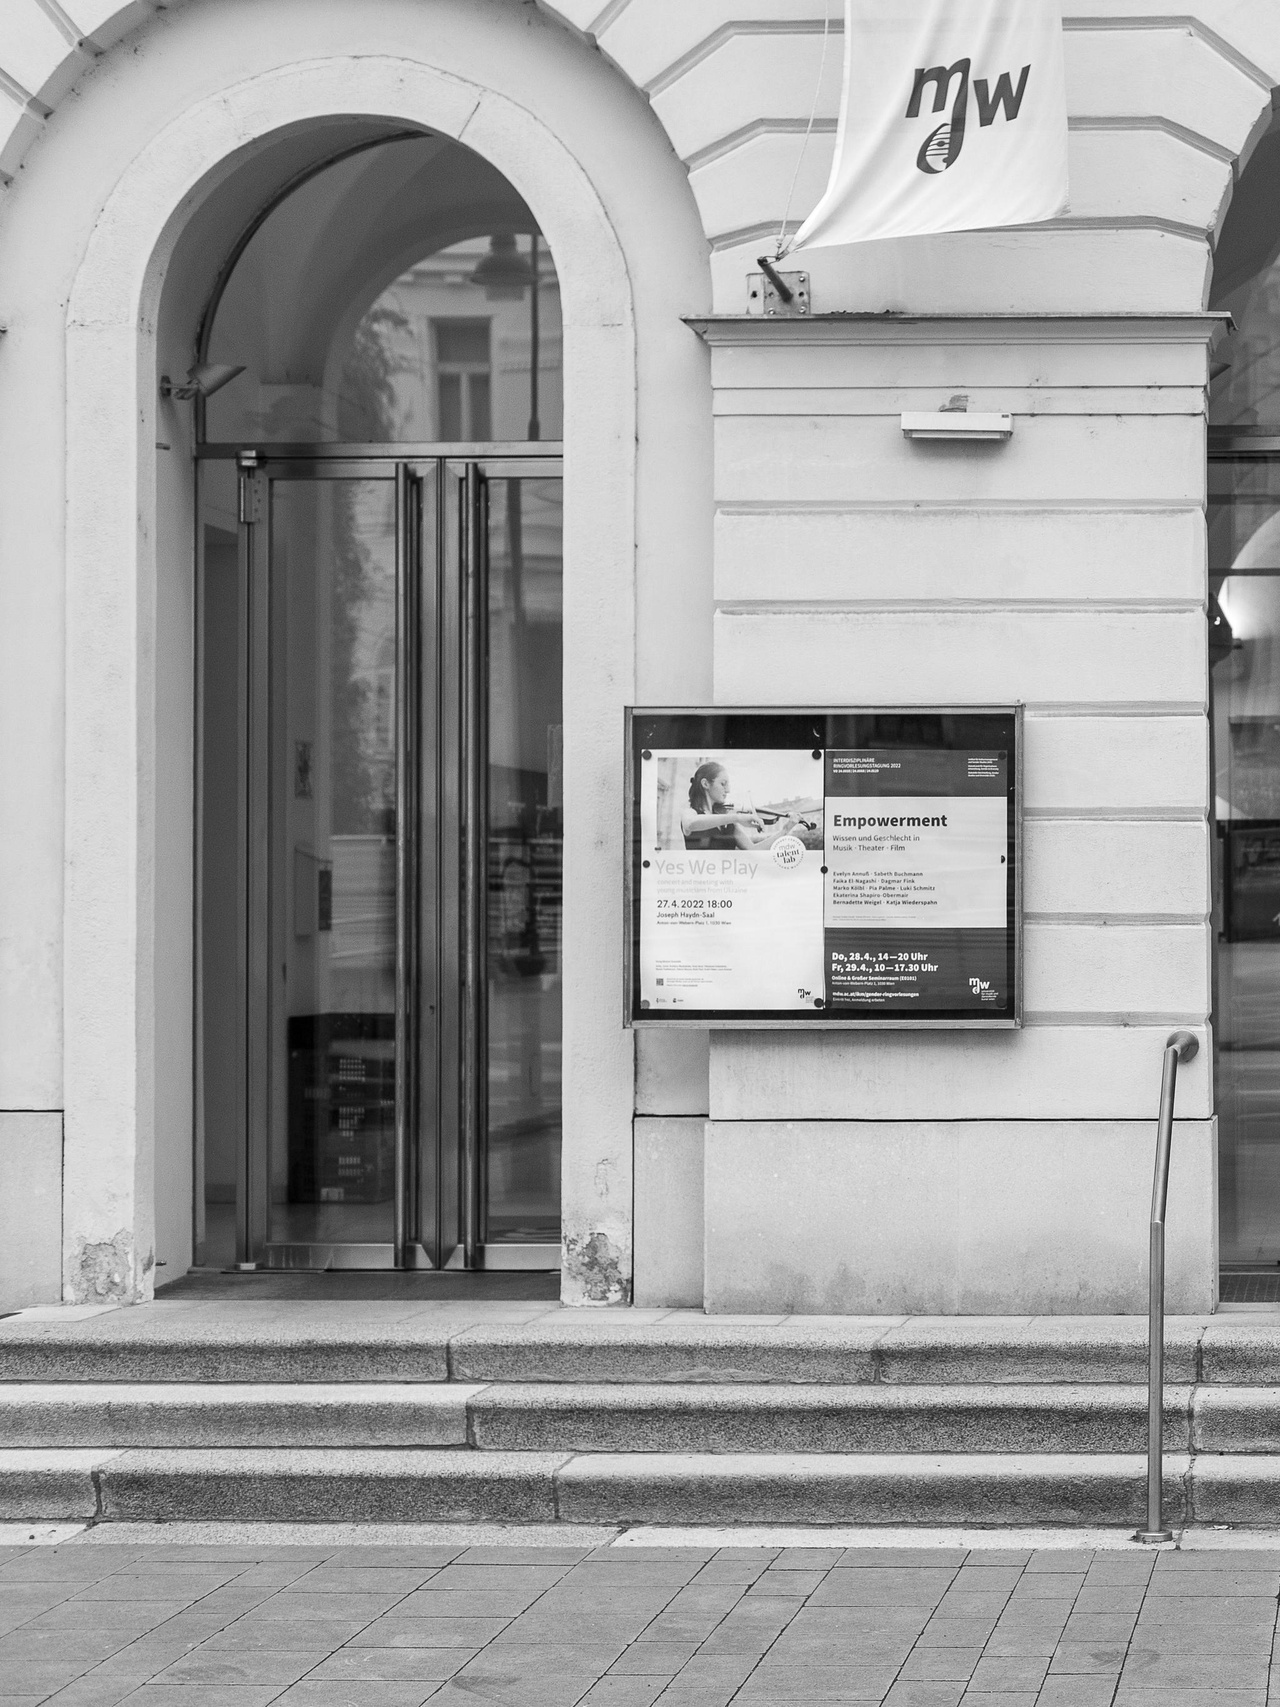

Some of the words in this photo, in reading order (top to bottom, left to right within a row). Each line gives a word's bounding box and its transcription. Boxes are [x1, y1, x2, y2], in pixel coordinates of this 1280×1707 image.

[834, 815, 948, 829] Empowerment
[777, 849, 799, 858] talent
[655, 859, 685, 875] Yes
[689, 859, 716, 875] We
[722, 859, 758, 879] Play
[707, 900, 733, 909] 18:00
[832, 953, 847, 962] Do,
[849, 952, 876, 962] 28.4.,
[910, 952, 928, 960] Uhr
[832, 963, 844, 973] Fr,
[845, 963, 872, 973] 29.4.,
[921, 963, 938, 971] Uhr
